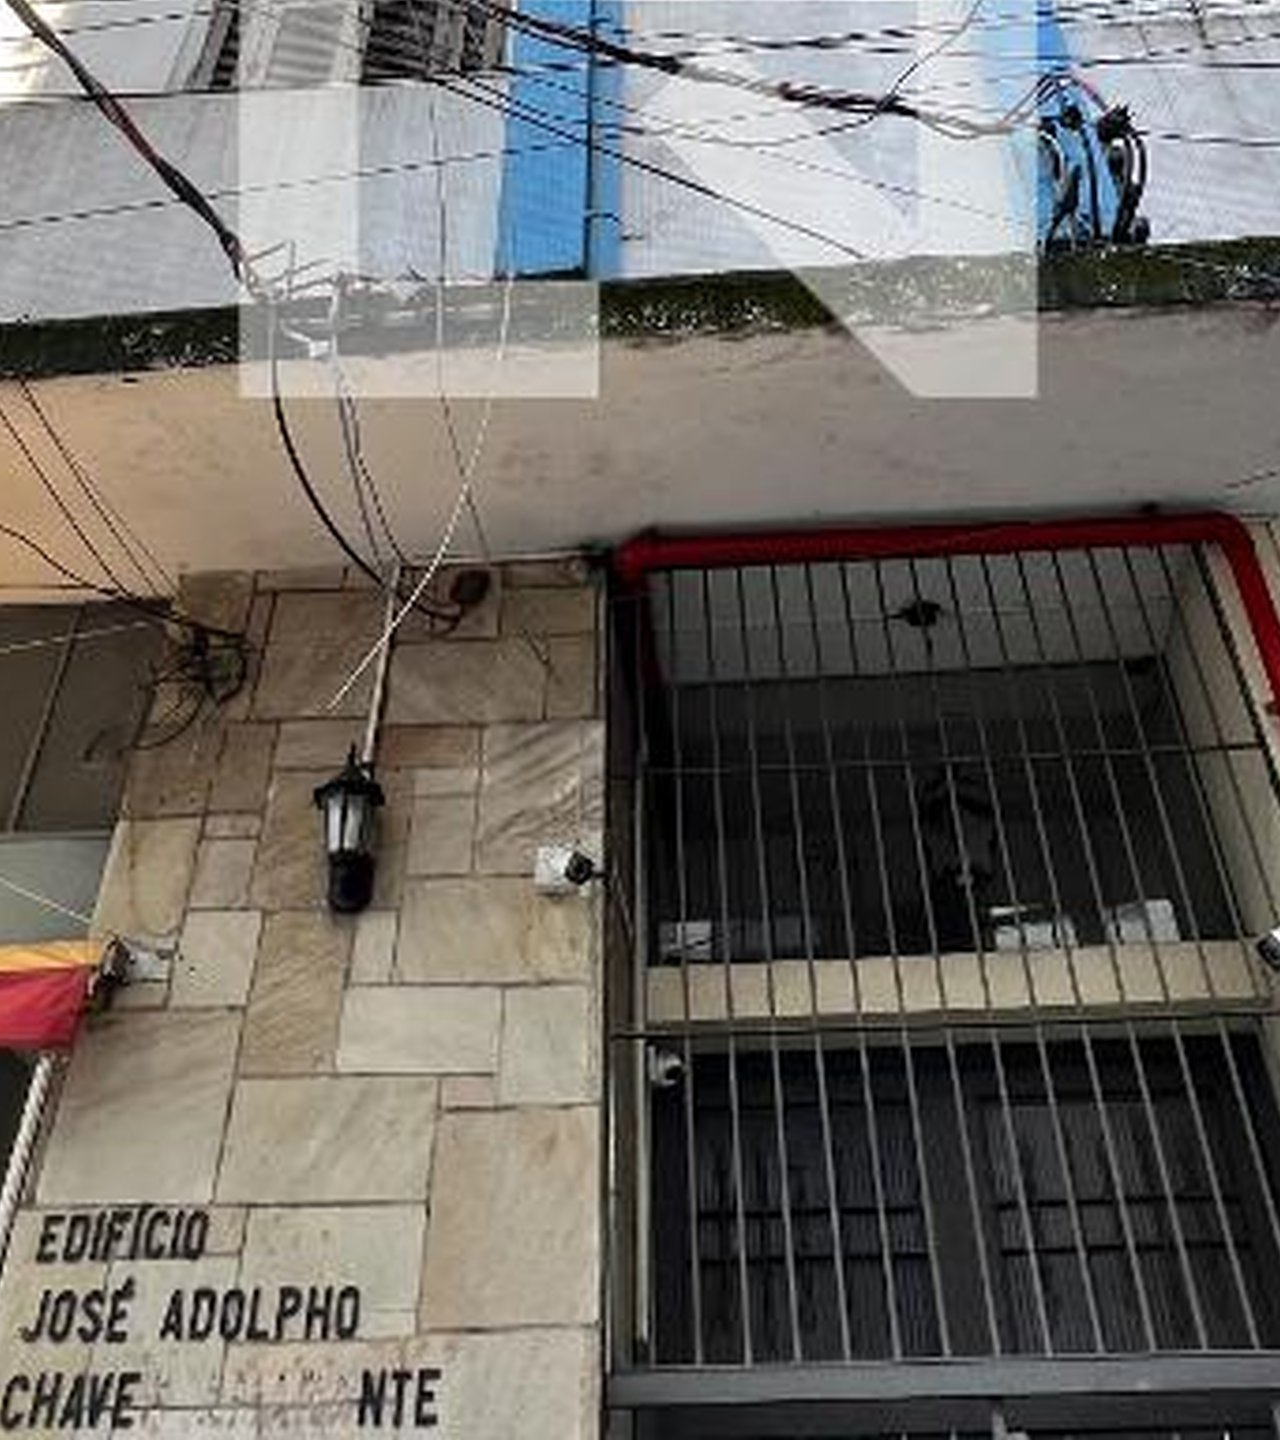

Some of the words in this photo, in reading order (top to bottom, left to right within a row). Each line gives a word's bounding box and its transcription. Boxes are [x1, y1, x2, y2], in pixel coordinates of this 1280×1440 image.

[35, 1204, 209, 1262] EDIFÍCIO
[19, 1277, 136, 1344] JOSÉ
[160, 1285, 363, 1342] ADOLPHO
